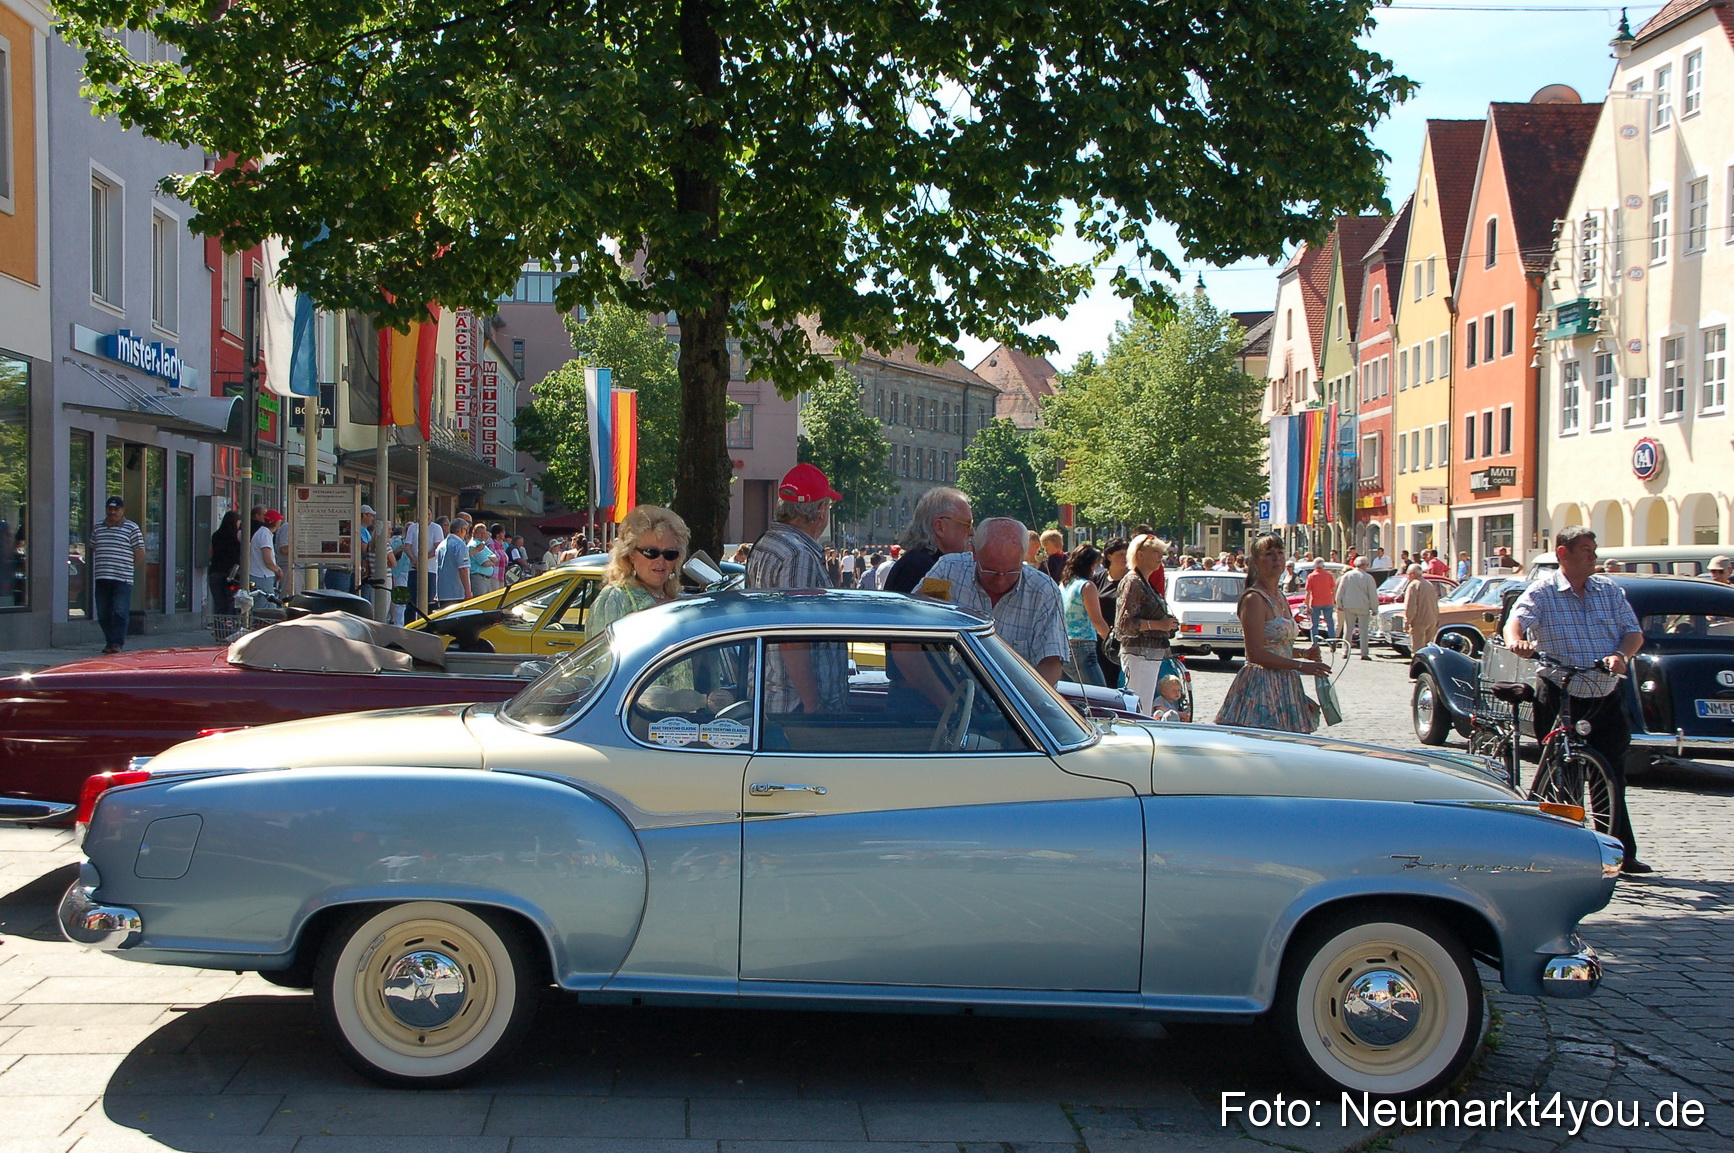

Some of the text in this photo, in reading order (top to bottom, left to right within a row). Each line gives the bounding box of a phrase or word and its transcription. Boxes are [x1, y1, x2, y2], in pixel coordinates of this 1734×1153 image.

[118, 330, 184, 388] mister lady
[1633, 449, 1653, 468] C&A
[1490, 468, 1515, 477] MATT
[1261, 503, 1268, 518] P
[1725, 673, 1734, 684] D
[1705, 702, 1722, 714] NM
